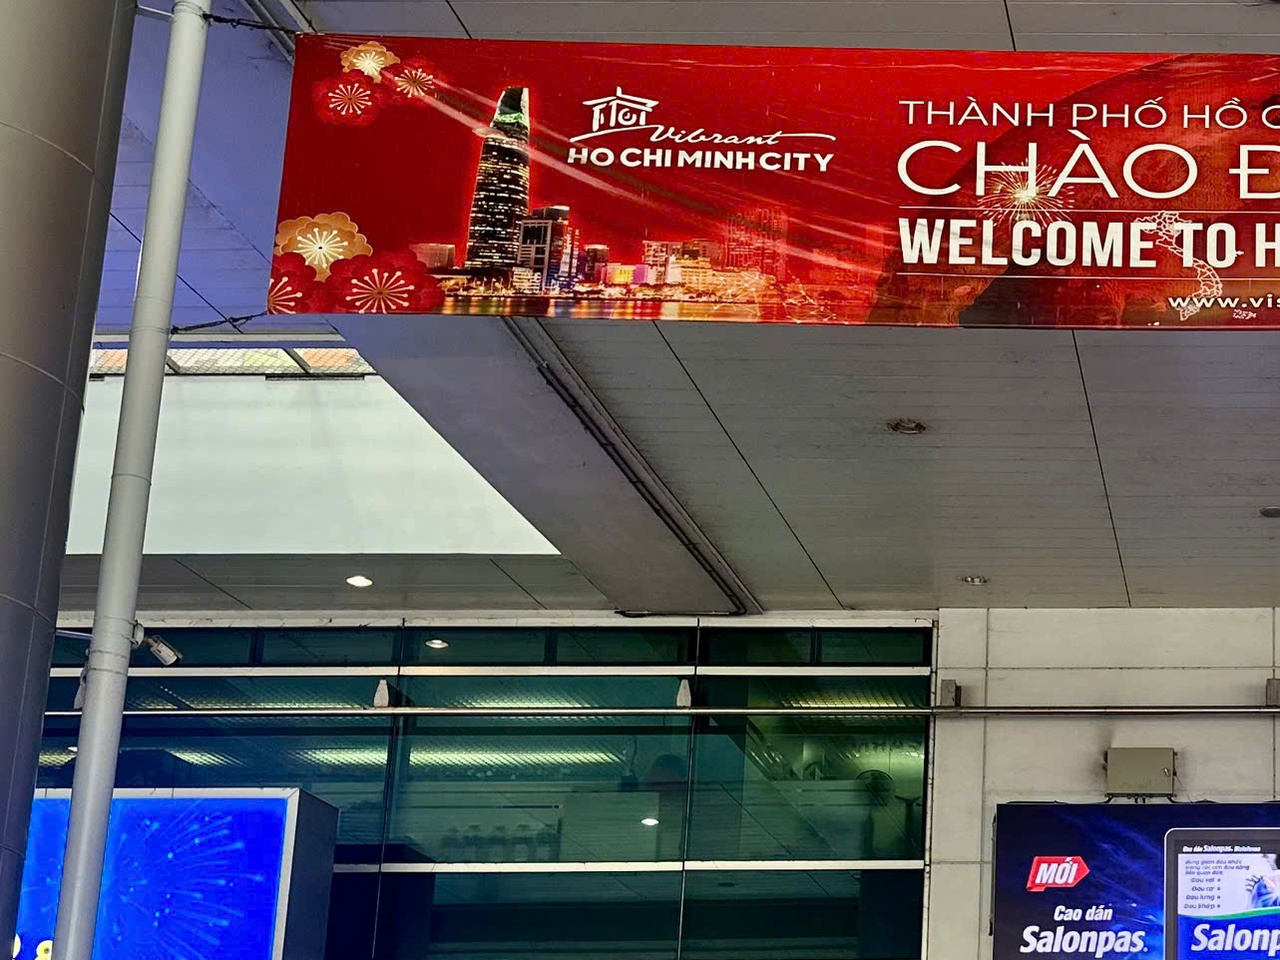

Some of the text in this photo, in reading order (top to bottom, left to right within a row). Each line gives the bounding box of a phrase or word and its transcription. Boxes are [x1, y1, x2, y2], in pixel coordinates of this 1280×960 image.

[899, 96, 1054, 127] THÀNH
[1072, 97, 1167, 128] PHỐ
[1183, 98, 1247, 129] HỒ
[649, 125, 810, 145] Vibrant
[567, 147, 835, 172] HO CHI MINH CITY
[898, 129, 1198, 199] CHÀO
[898, 218, 1157, 268] WELCOME
[1175, 222, 1236, 268] TO
[1035, 857, 1079, 884] MỚI
[1053, 905, 1113, 921] Cao dán
